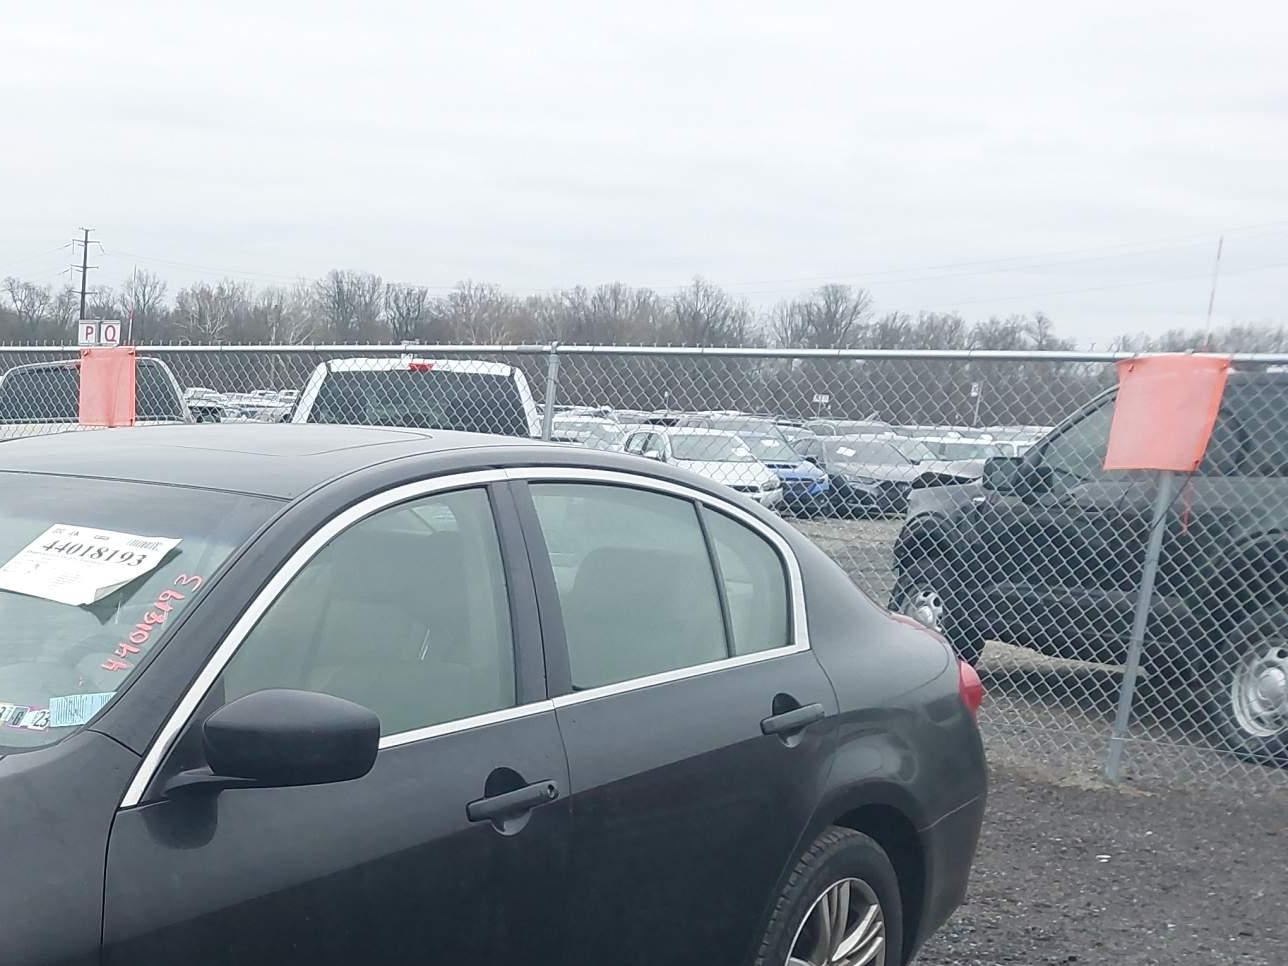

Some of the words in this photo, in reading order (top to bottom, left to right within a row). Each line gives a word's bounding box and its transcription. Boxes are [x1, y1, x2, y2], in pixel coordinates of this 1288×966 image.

[85, 325, 94, 341] P
[104, 324, 117, 343] Q
[43, 539, 148, 567] 44018193
